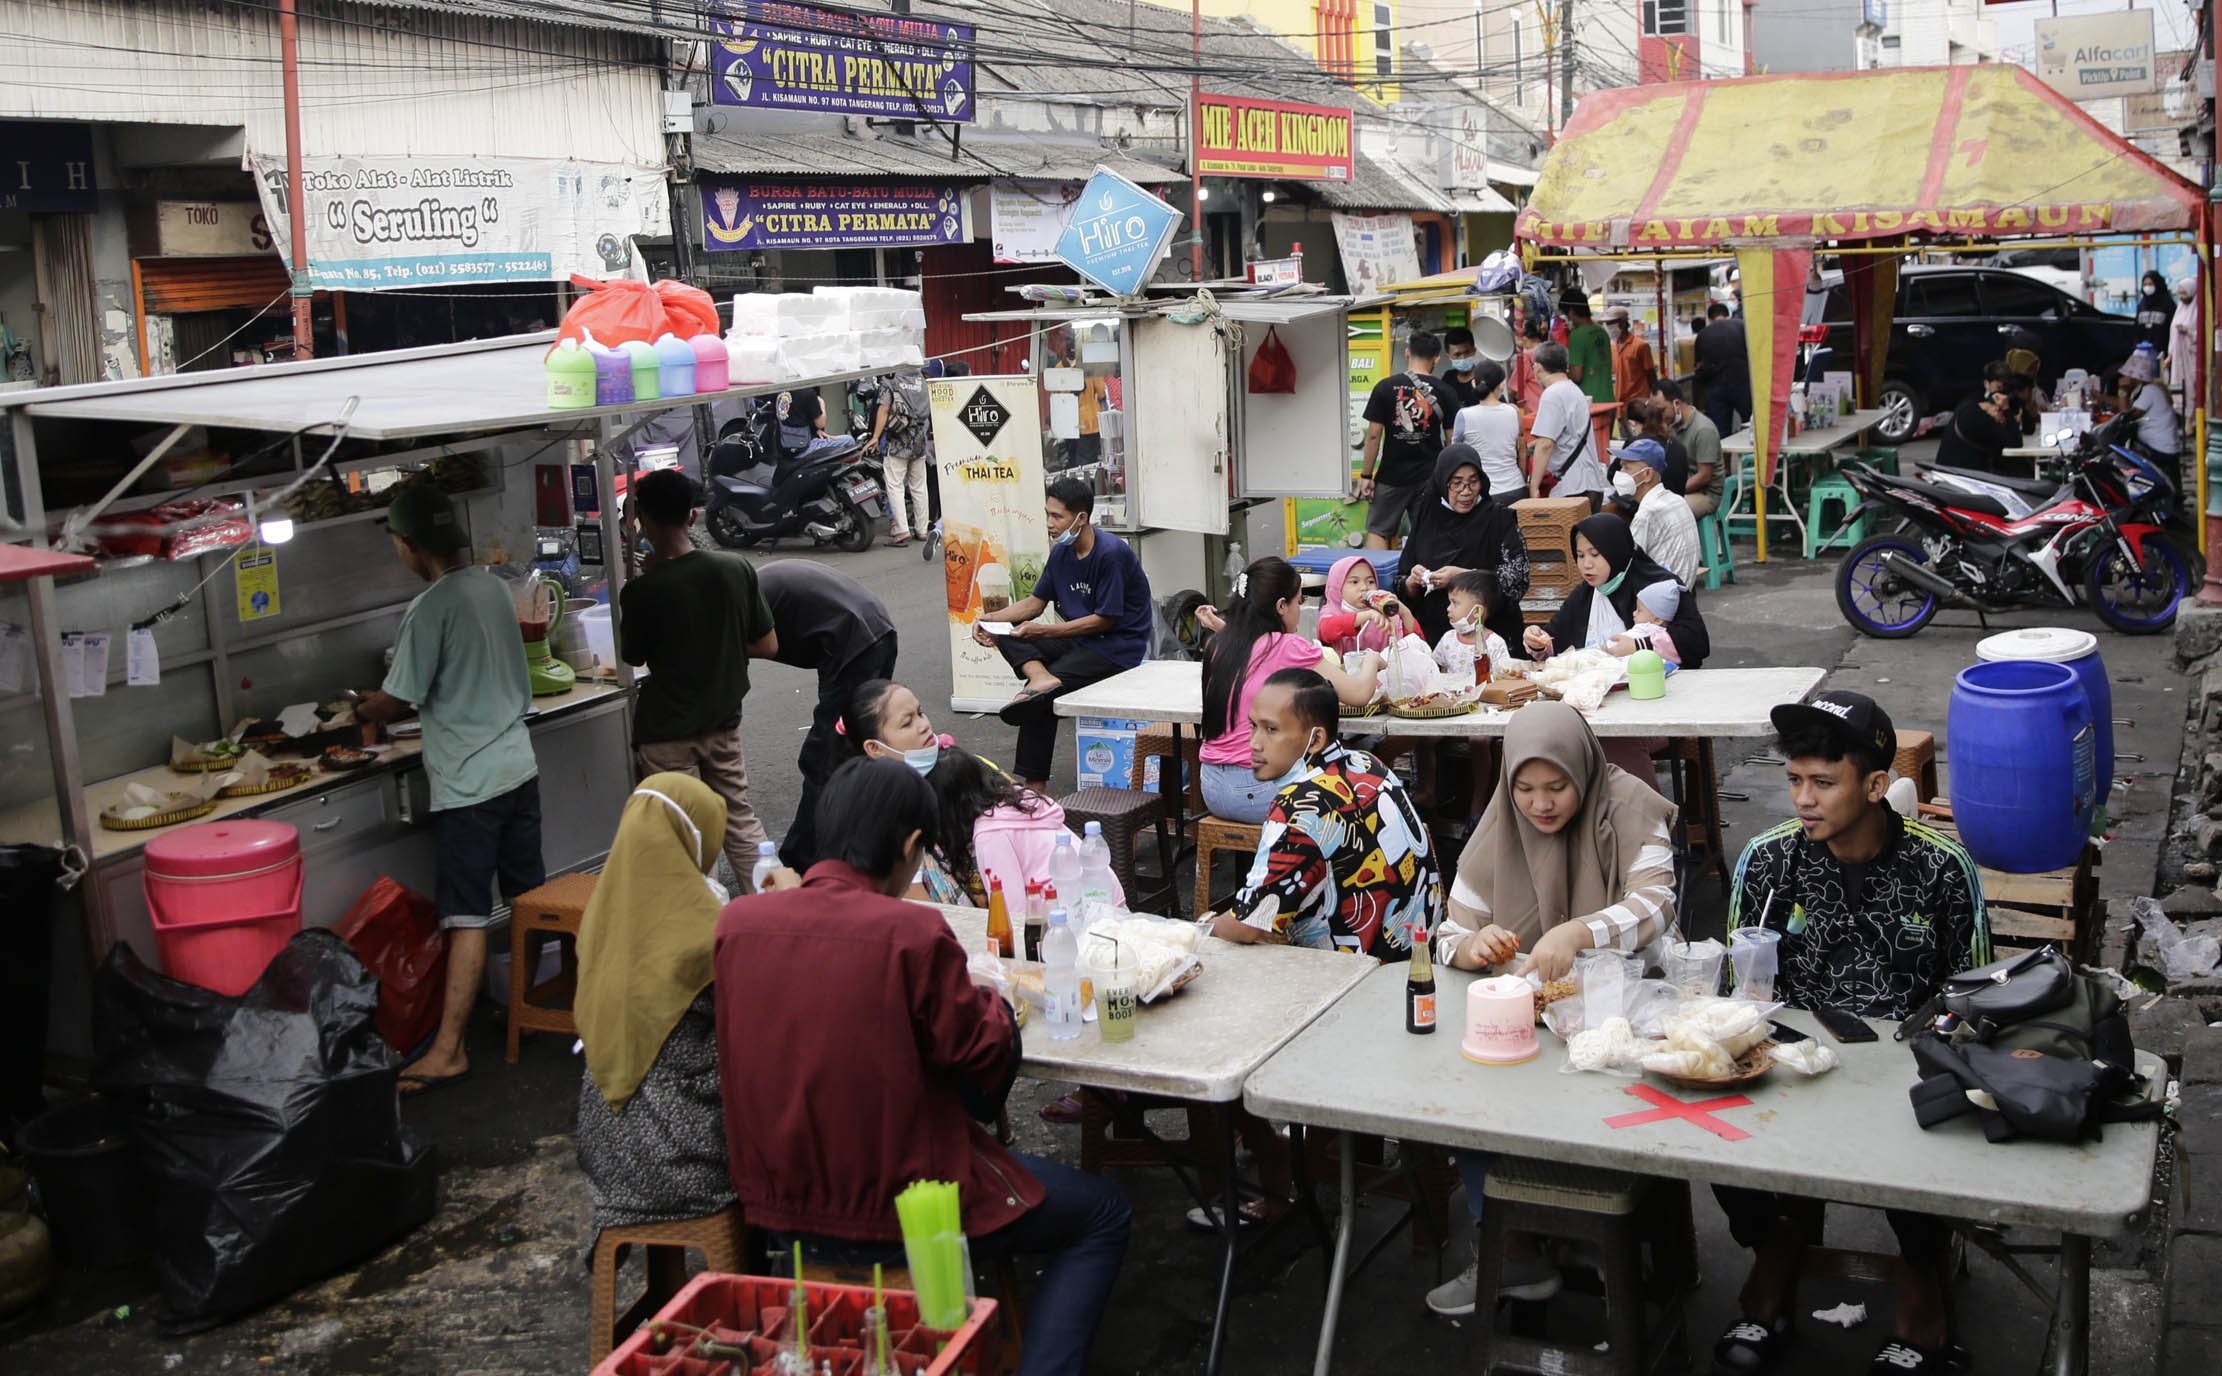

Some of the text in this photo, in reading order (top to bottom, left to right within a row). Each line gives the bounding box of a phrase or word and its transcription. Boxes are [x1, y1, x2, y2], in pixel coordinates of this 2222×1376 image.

[772, 31, 802, 44] SAPIRE
[810, 33, 832, 46] RUBY
[840, 37, 857, 49] CAT
[857, 39, 873, 52] EYE
[2075, 44, 2150, 64] Alfacart
[2083, 69, 2142, 84] PickUp Point
[762, 92, 771, 101] JL.
[773, 93, 807, 104] KISAMAUN
[809, 95, 820, 105] NO.
[821, 97, 829, 105] 97
[831, 97, 847, 107] KOTA
[849, 99, 884, 110] TANGERANG
[886, 102, 902, 111] TELP.
[1200, 102, 1349, 158] MIE ACEH KINGDOM
[302, 170, 352, 191] Toko
[355, 169, 398, 189] Alat
[410, 168, 451, 188] Alat
[452, 168, 513, 188] Listrik
[749, 186, 936, 198] BURSA BATU-BATU MULIA
[766, 202, 797, 210] SAPIRE
[804, 202, 826, 210] RUBY
[834, 202, 850, 210] CAT
[186, 206, 218, 225] TOKO
[352, 200, 478, 248] Seruling
[1811, 202, 2112, 235] KISAMAUN
[1079, 216, 1146, 255] Hiro
[1637, 214, 1780, 241] AYAM
[766, 237, 800, 245] KISAMAUN
[842, 235, 878, 243] TANGERANG
[384, 265, 413, 279] Telp.
[416, 263, 445, 276] (021)
[450, 262, 495, 275] 5583577
[505, 261, 547, 273] 5522463
[1351, 358, 1376, 369] BALI
[1348, 375, 1369, 384] RGA
[931, 388, 954, 397] MOOD
[968, 407, 999, 423] Hiro
[966, 467, 1014, 479] THAI TEA
[1106, 987, 1134, 997] EVER
[1109, 1010, 1135, 1020] BOOS
